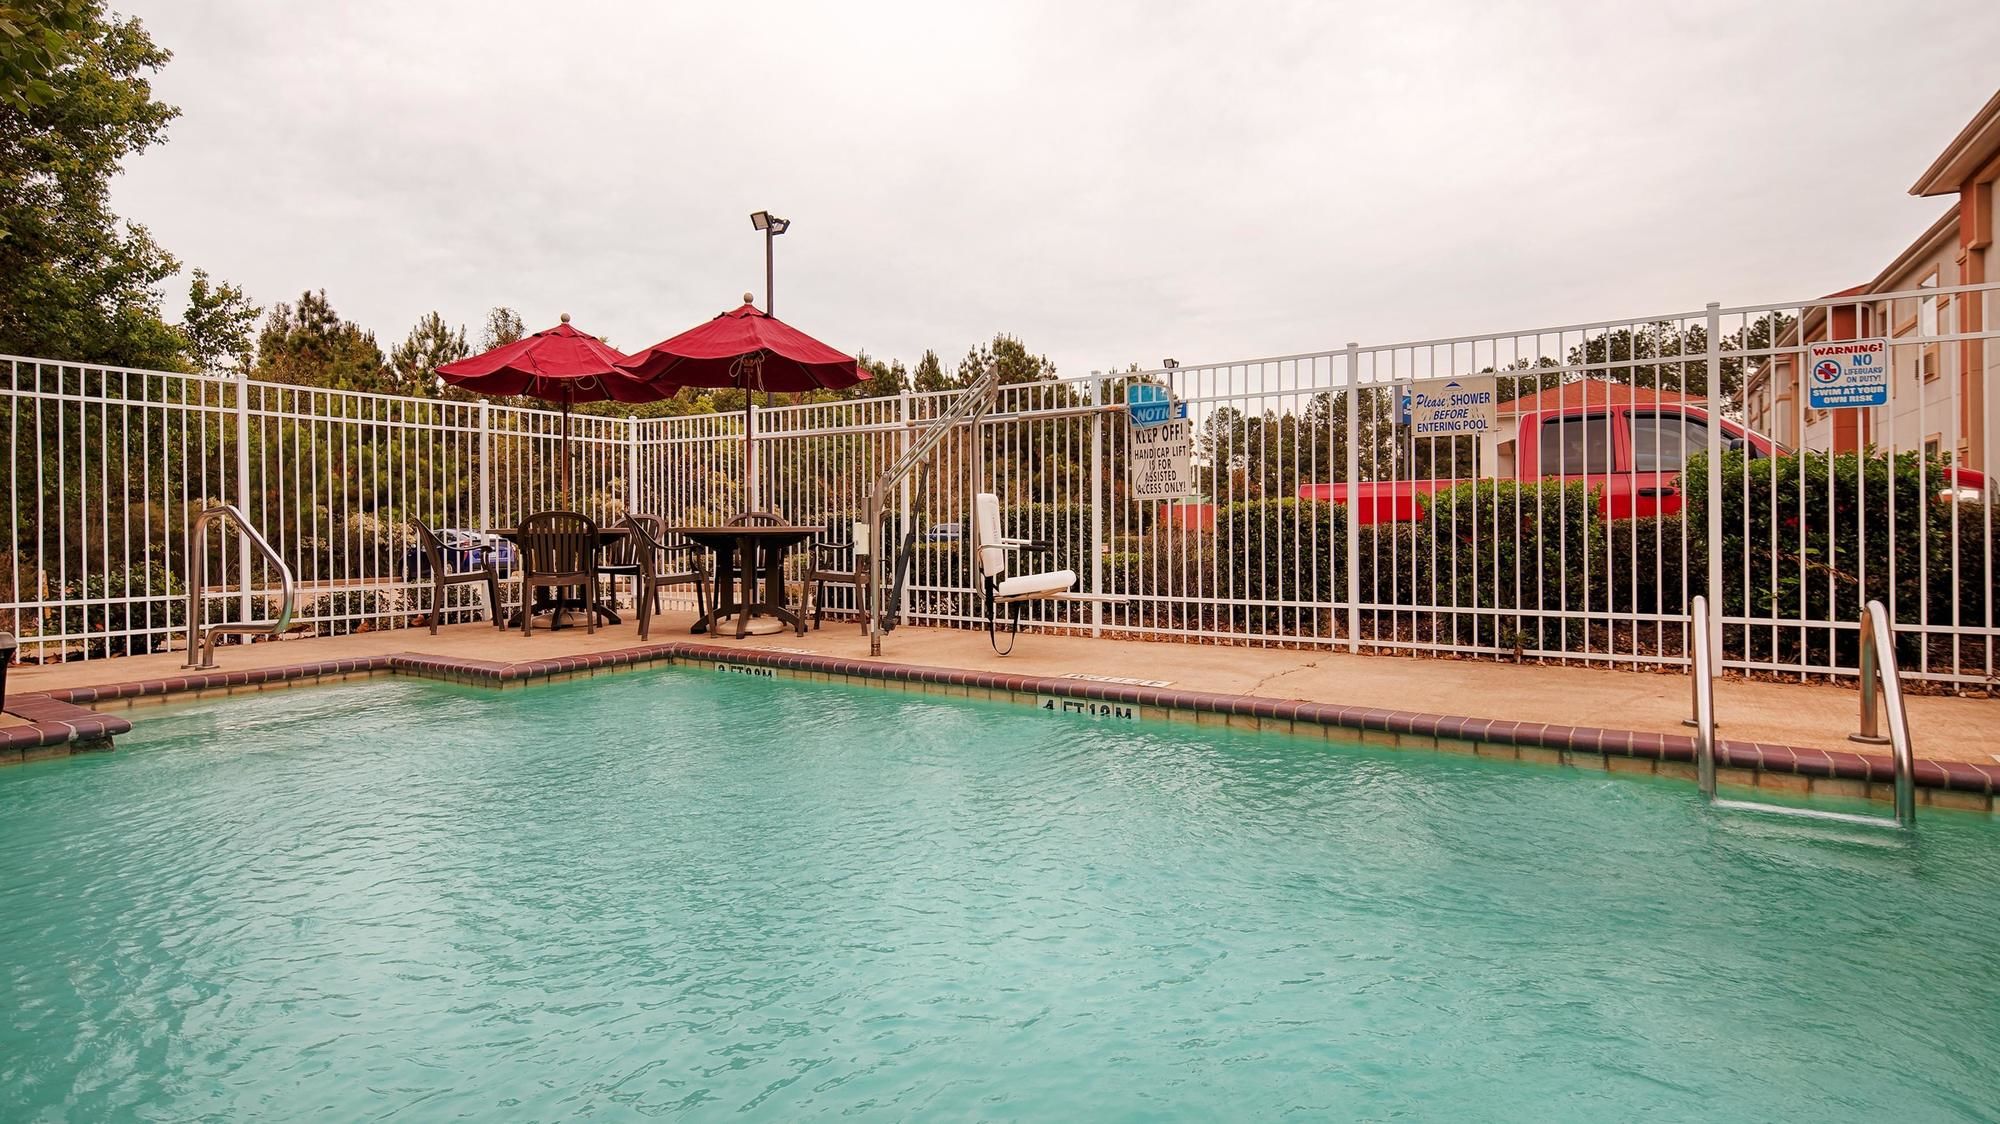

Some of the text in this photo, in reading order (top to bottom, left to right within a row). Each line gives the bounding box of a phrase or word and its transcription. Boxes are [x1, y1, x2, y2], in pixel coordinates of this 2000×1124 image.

[1813, 343, 1883, 356] WARNING!
[1853, 354, 1872, 366] NO
[1844, 366, 1883, 376] LIFEGUARD
[1860, 375, 1882, 383] DUTY!
[1813, 386, 1885, 397] SWIM AT YOUR
[1416, 392, 1491, 409] Please SHOWER
[1823, 394, 1873, 404] OWN RISK
[1433, 408, 1469, 420] BEFORE
[1417, 419, 1489, 433] ENTERING POOL
[1135, 423, 1184, 444] KEEP OFF!
[1172, 445, 1187, 457] LIFT
[1149, 458, 1172, 471] IS FOR
[1145, 470, 1177, 483] ASSISTED
[1137, 480, 1187, 495] ACCESS ONLY!
